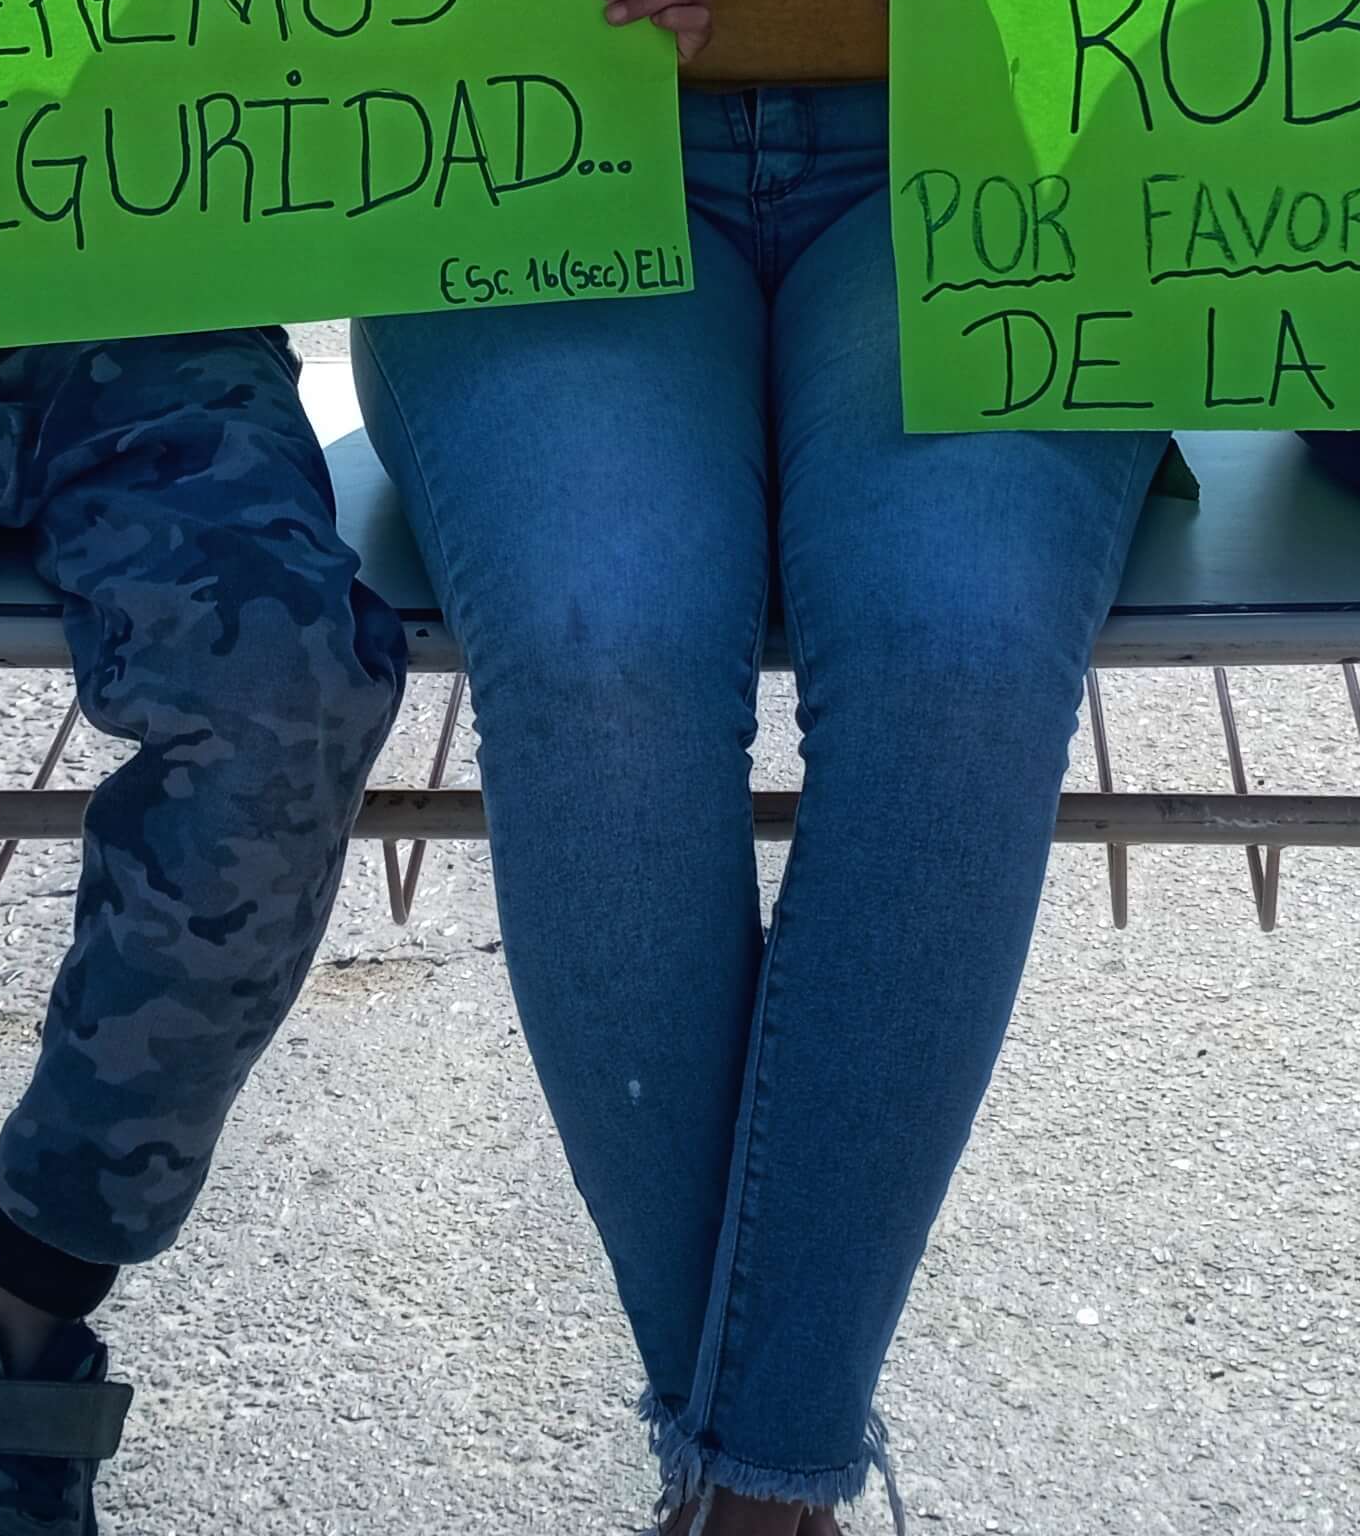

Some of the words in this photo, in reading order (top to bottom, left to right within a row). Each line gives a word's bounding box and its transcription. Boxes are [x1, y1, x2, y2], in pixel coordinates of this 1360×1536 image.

[900, 168, 1077, 282] POR
[961, 308, 1153, 418] DE
[1204, 305, 1336, 411] LA
